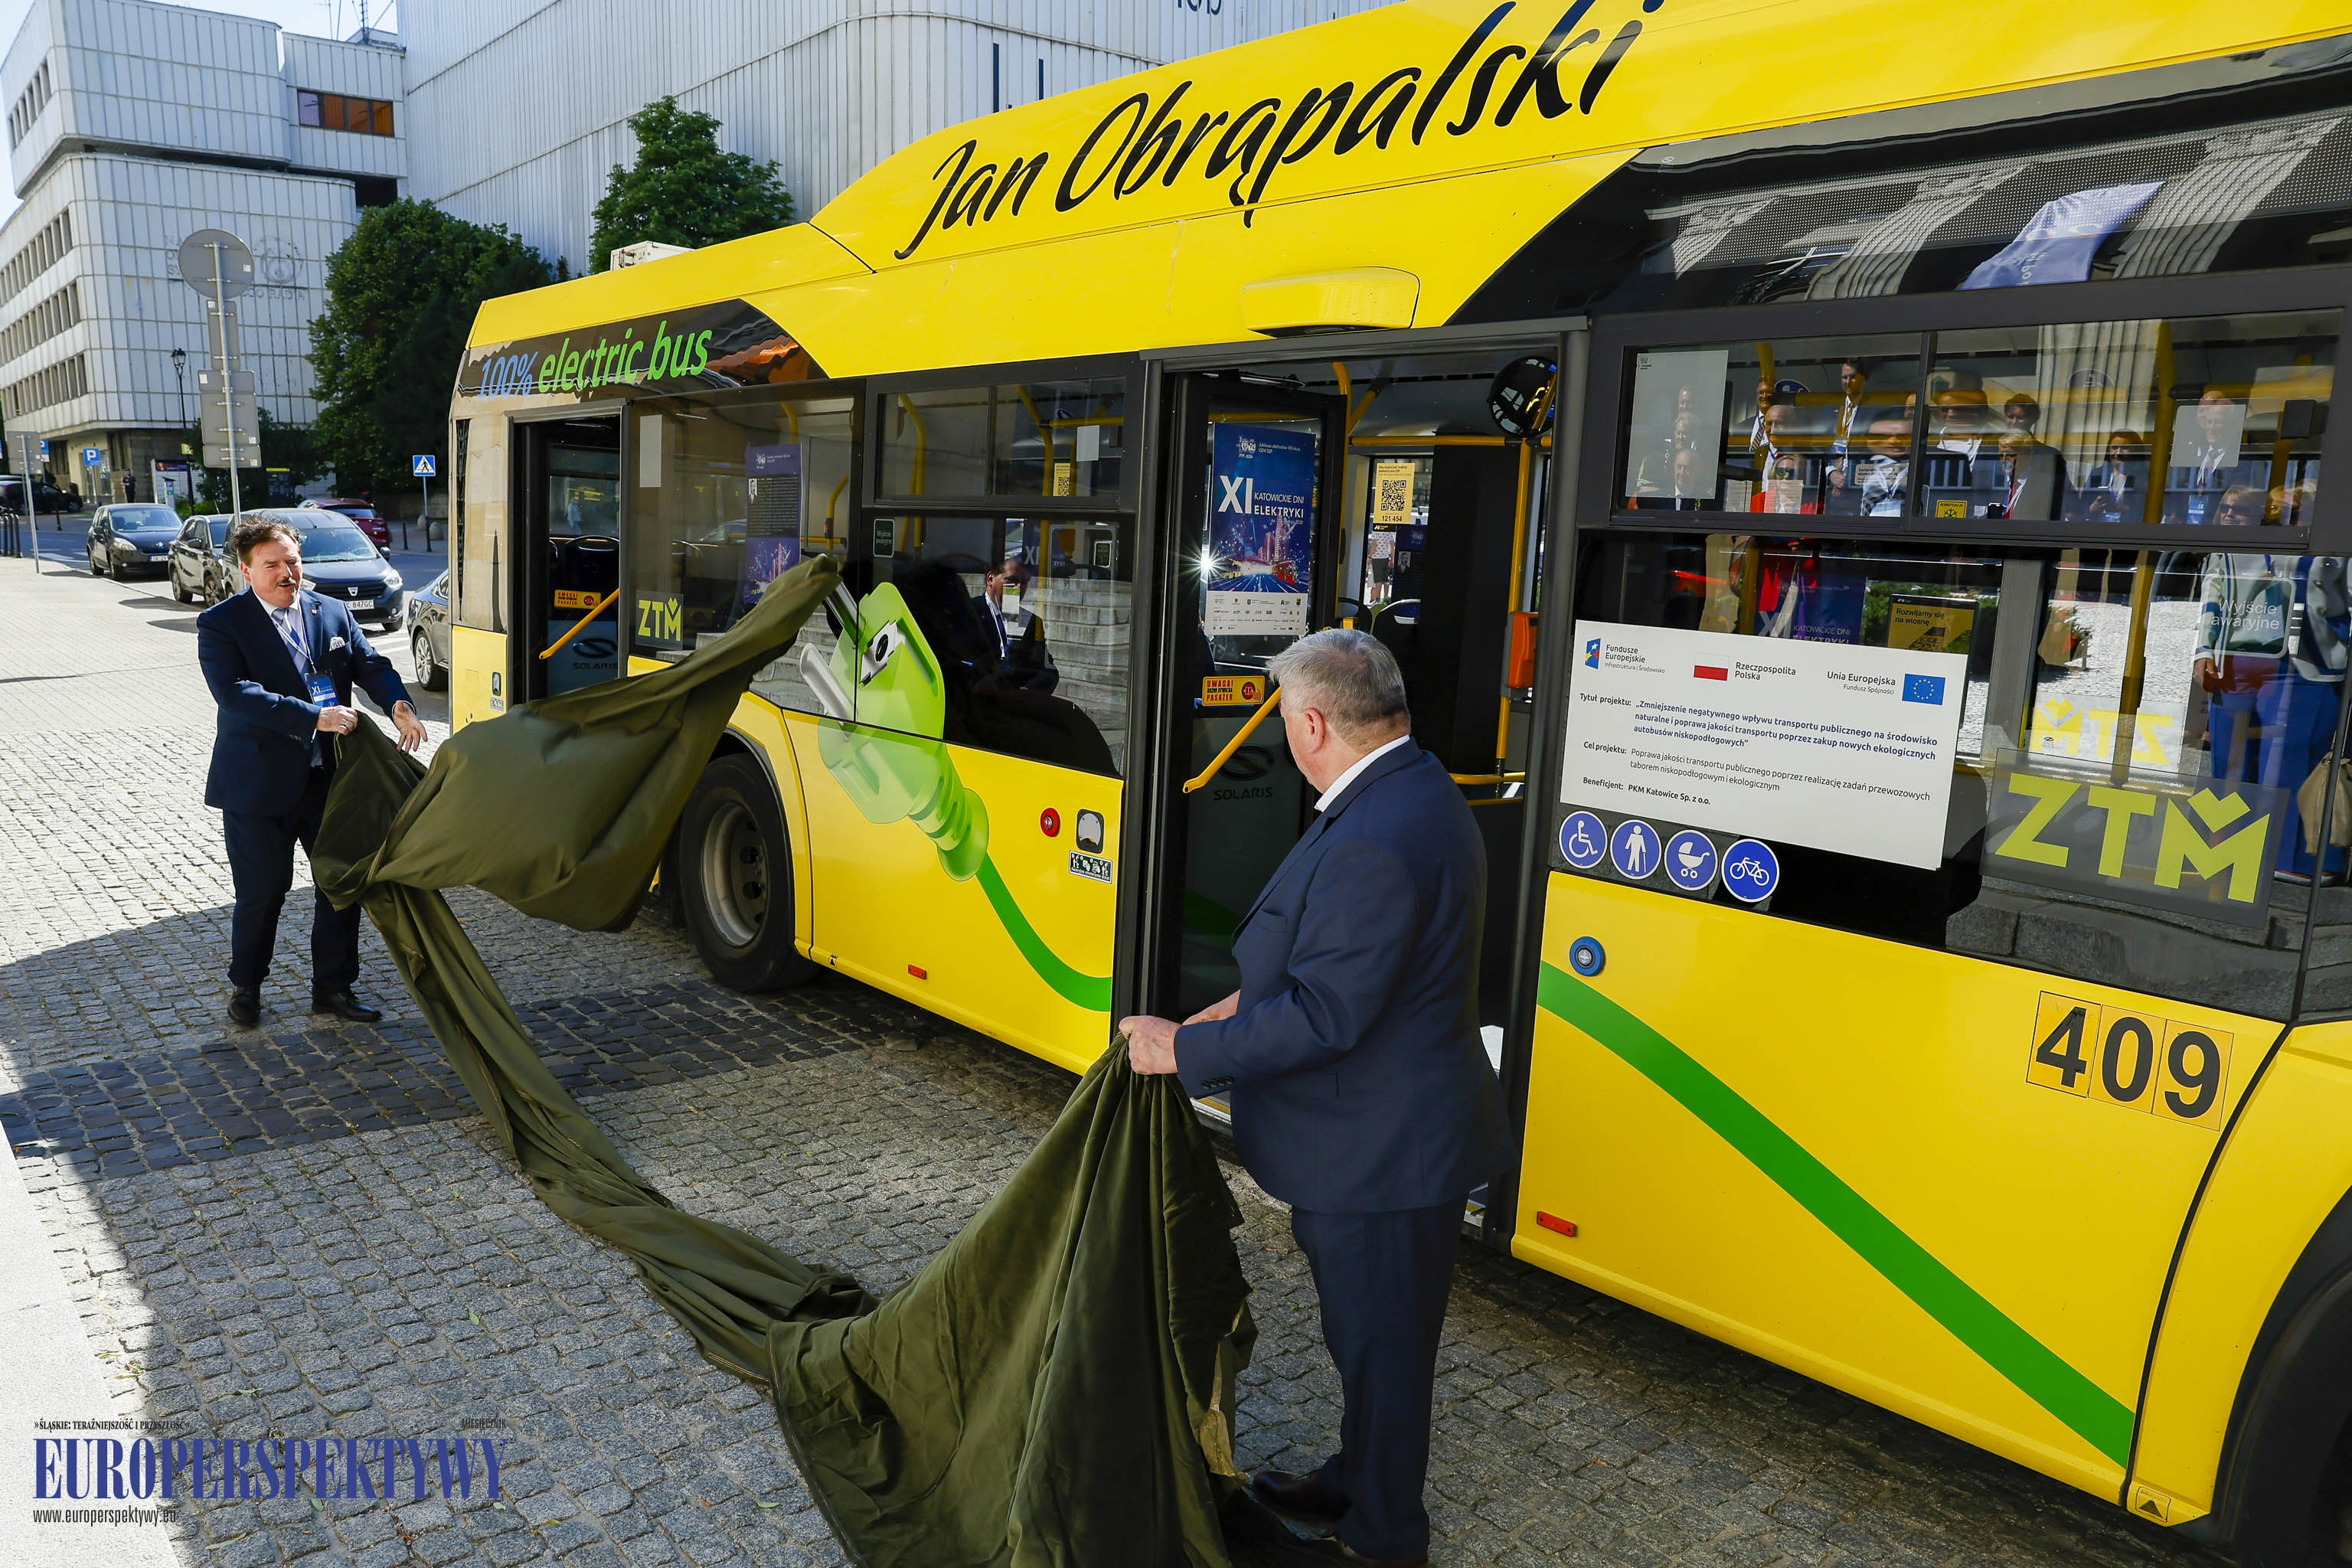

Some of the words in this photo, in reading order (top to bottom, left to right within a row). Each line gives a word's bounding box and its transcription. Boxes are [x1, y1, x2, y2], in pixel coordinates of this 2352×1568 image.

[893, 139, 1049, 260] Jan
[1054, 0, 1664, 228] Obrąpalski
[475, 351, 539, 401] 100%
[537, 328, 644, 393] electric
[647, 320, 713, 381] bus
[86, 449, 96, 461] P
[1218, 475, 1253, 514] XI
[1254, 492, 1292, 502] KATOWICKIE
[1293, 495, 1305, 504] DNI
[1254, 505, 1304, 518] ELEKTRYKI
[1896, 607, 1932, 619] Rozwijamy
[2220, 600, 2277, 616] Wyjście
[638, 597, 682, 642] ZTM
[1905, 616, 1930, 626] wiosnę
[2210, 616, 2280, 632] awaryjne
[1793, 626, 1835, 634] KATOWICKIE
[1837, 627, 1851, 635] DNI
[1606, 644, 1638, 654] Fundusze
[1605, 652, 1645, 664] Europejskie
[1604, 662, 1636, 671] Infrastruktura
[1638, 665, 1665, 674] Środowisko
[1736, 662, 1796, 675] Rzeczpospolita
[1735, 671, 1761, 681] Polska
[1827, 671, 1846, 681] Unia
[1848, 673, 1896, 686] Europejska
[1206, 693, 1233, 701] PASAŻER
[1867, 686, 1895, 695] Spójności
[1579, 693, 1597, 702] Tytuł
[1599, 696, 1632, 706] projektu:
[1635, 701, 1687, 714] „Zmniejszenie
[1688, 707, 1740, 721] negatywnego
[1742, 713, 1772, 725] wpływu
[1775, 718, 1818, 731] transportu
[1821, 724, 1872, 740] publicznego
[1886, 731, 1938, 746] środowisko
[1634, 725, 1674, 737] autobusów
[1674, 731, 1749, 747] niskopodłogowych”
[1635, 713, 1670, 724] naturalne
[1674, 719, 1707, 729] poprawa
[1707, 722, 1733, 733] jakości
[1735, 727, 1777, 739] transportu
[1779, 732, 1811, 744] poprzez
[1812, 737, 1838, 748] zakup
[1839, 740, 1871, 753] nowych
[1873, 744, 1936, 760] ekologicznych
[1595, 744, 1627, 754] projektu:
[1631, 748, 1661, 760] Poprawa
[1661, 752, 1685, 763] jakości
[1686, 756, 1724, 769] transportu
[1726, 763, 1771, 777] publicznego
[1772, 769, 1803, 782] poprzez
[1804, 775, 1841, 789] realizację
[1842, 780, 1867, 791] zadań
[1868, 785, 1930, 801] przewozowych
[1630, 761, 1660, 772] taborem
[1660, 766, 1725, 782] niskopodłogowym
[1729, 776, 1780, 791] ekologicznym
[1213, 787, 1274, 801] SOLARIS
[1583, 776, 1624, 790] Beneficjent:
[1628, 785, 1645, 794] PKM
[1646, 787, 1678, 799] Katowice
[1680, 793, 1690, 802] Sp.
[1994, 772, 2271, 904] ZTM
[2036, 1005, 2221, 1119] 409
